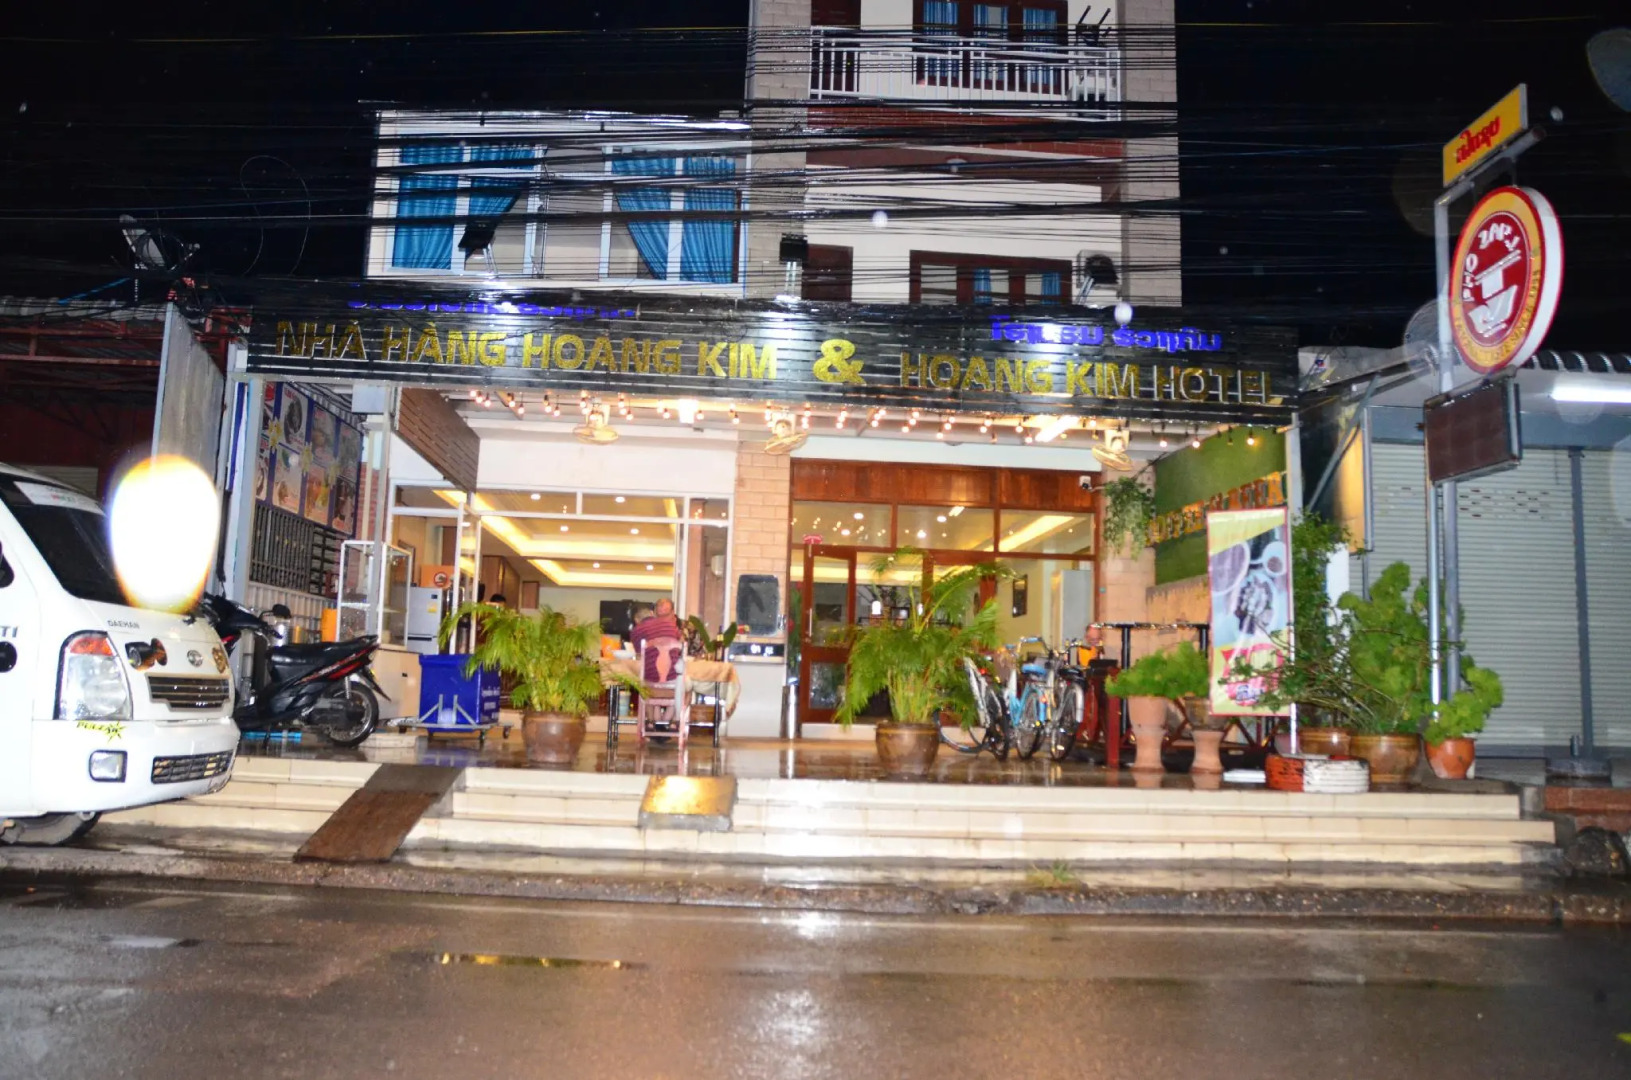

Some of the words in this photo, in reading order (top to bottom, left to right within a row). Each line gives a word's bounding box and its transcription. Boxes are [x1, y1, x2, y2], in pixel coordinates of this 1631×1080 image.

[697, 340, 778, 379] KIM
[812, 338, 867, 386] &
[900, 351, 1052, 395] HOANG
[1065, 359, 1141, 399] KIM
[1153, 365, 1284, 406] HOTEL
